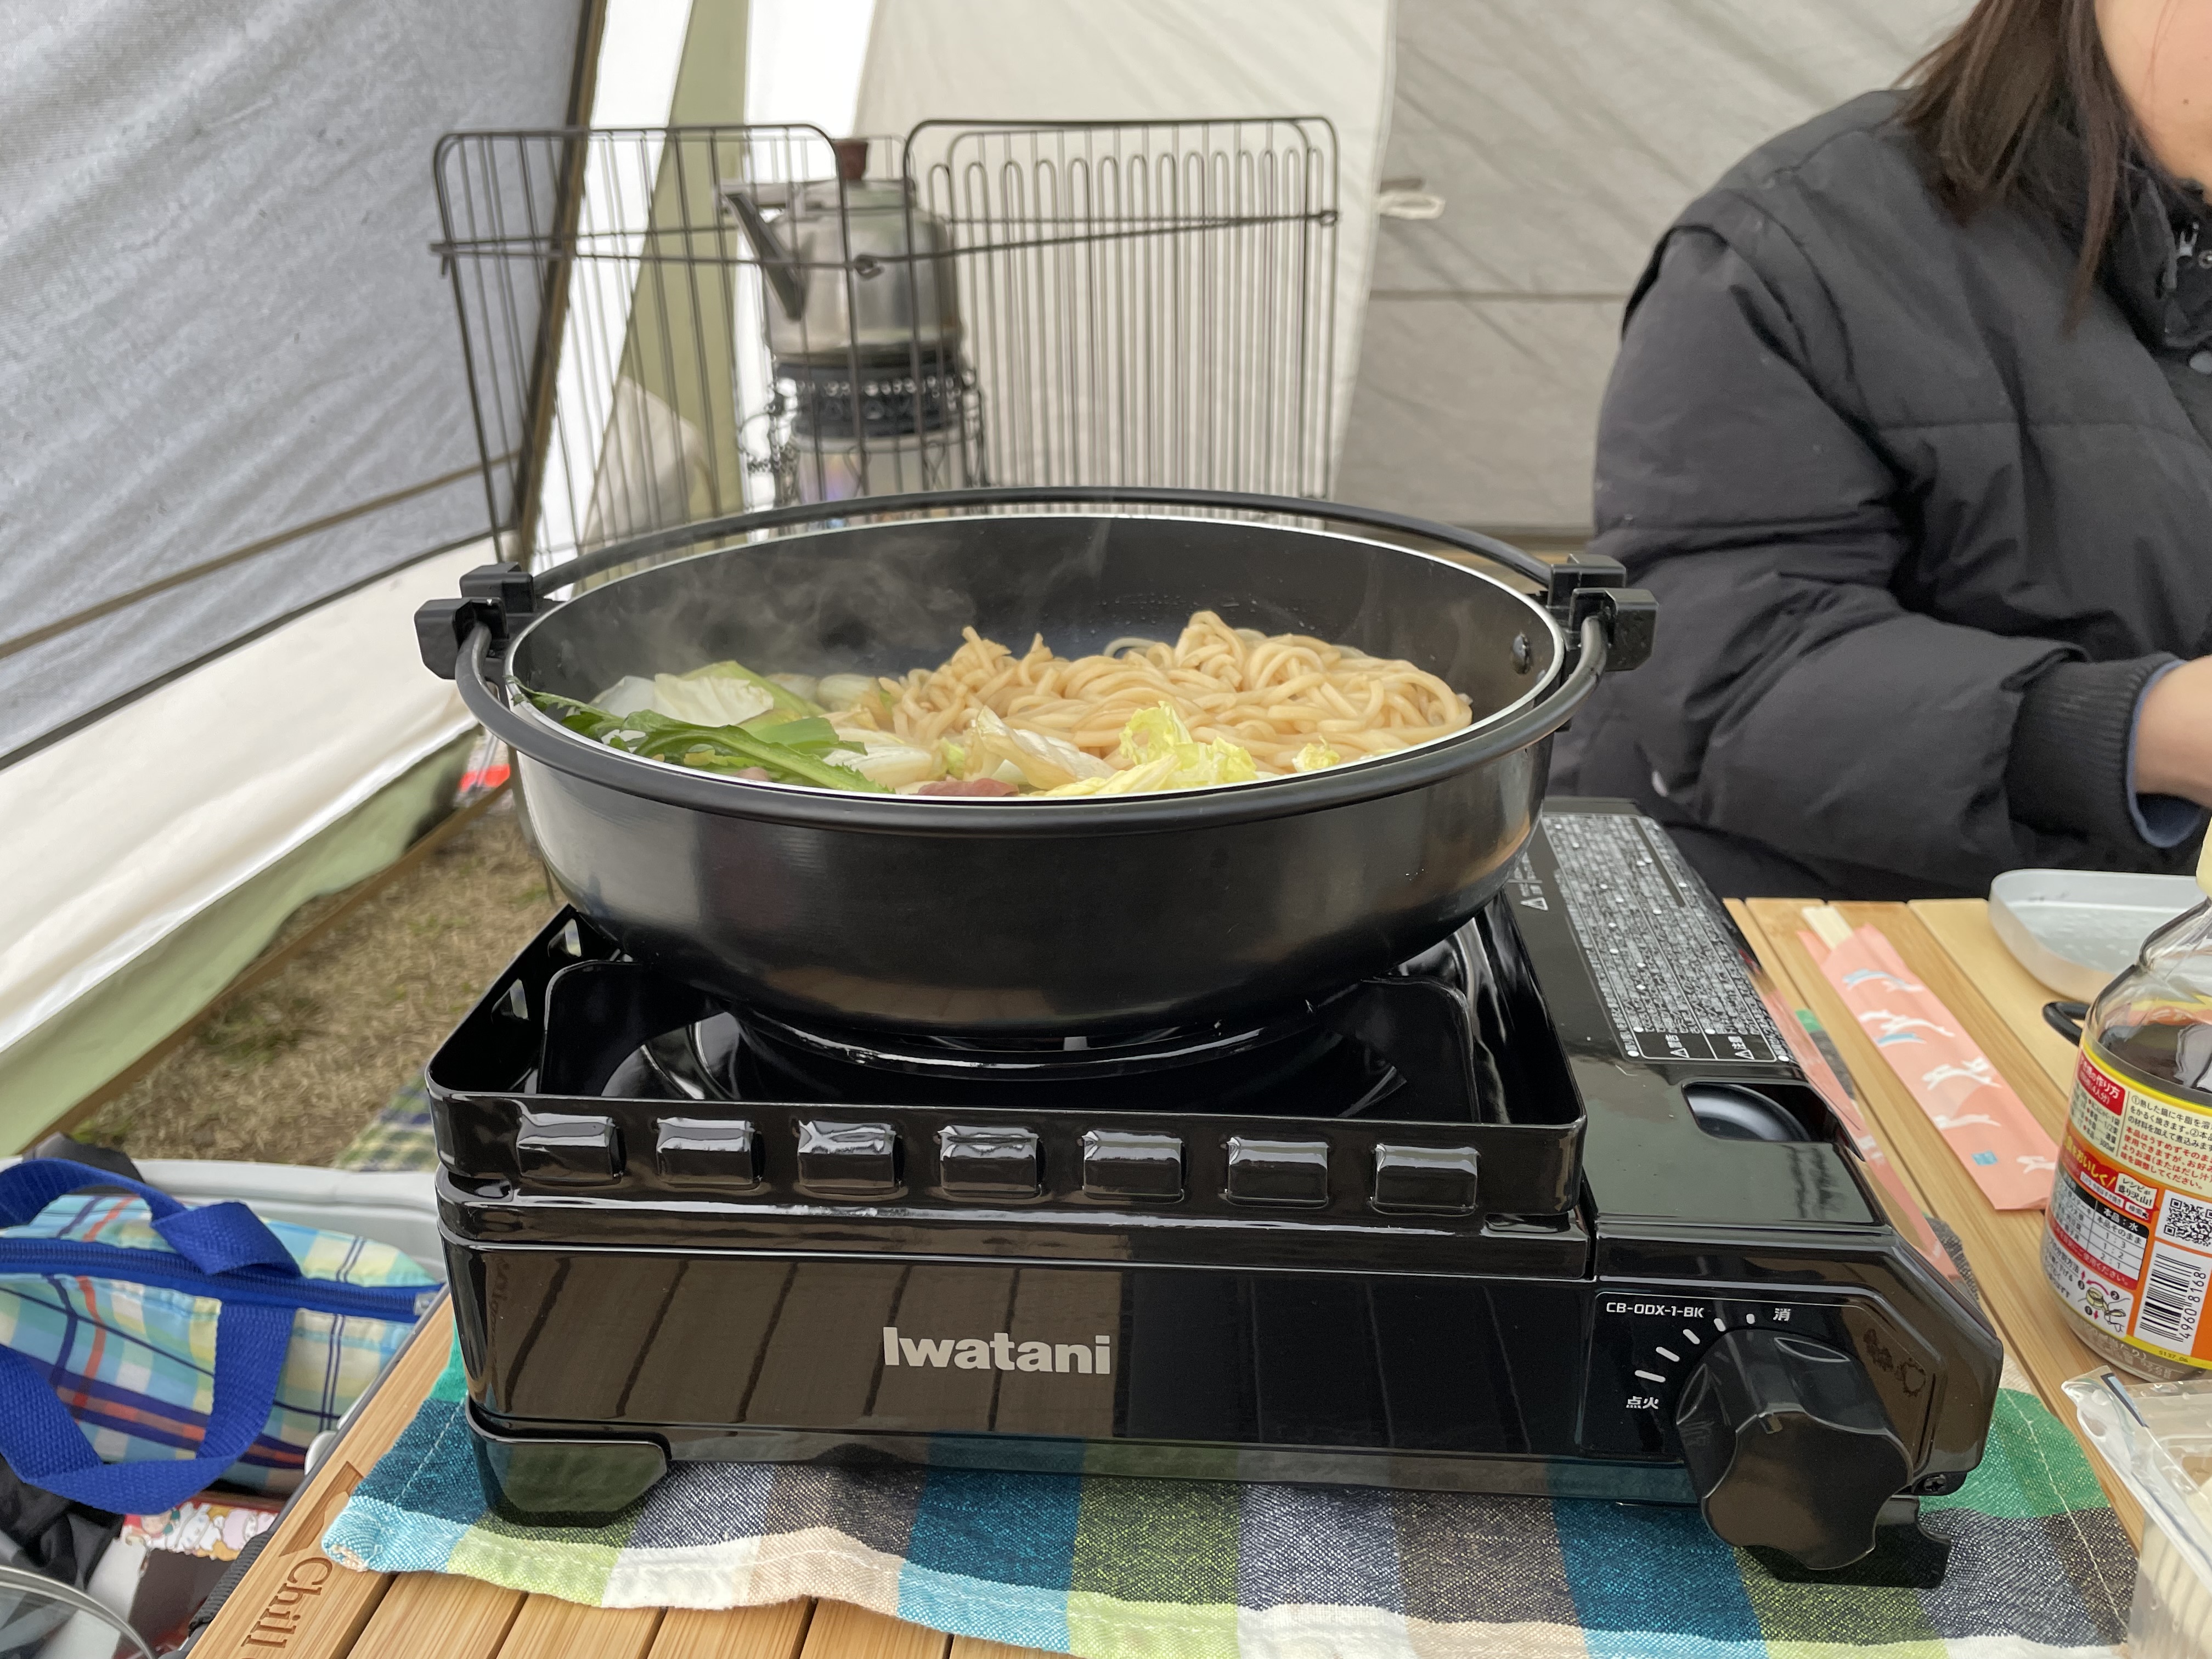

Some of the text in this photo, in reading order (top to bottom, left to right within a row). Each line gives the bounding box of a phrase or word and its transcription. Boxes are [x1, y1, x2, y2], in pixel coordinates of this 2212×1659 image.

[2131, 1095, 2212, 1130] ①熱した鍋に牛脂を溶
[2126, 1126, 2212, 1163] 本品はうすめずそのま
[2120, 1152, 2202, 1189] 味を調整してください。
[2123, 1178, 2151, 1195] レシピが
[2097, 1216, 2142, 1245] 本品そのまま
[1773, 1308, 1791, 1322] 消
[883, 1327, 1110, 1374] Iwatani
[1626, 1396, 1660, 1409] 点火
[241, 1557, 332, 1649] Chill
